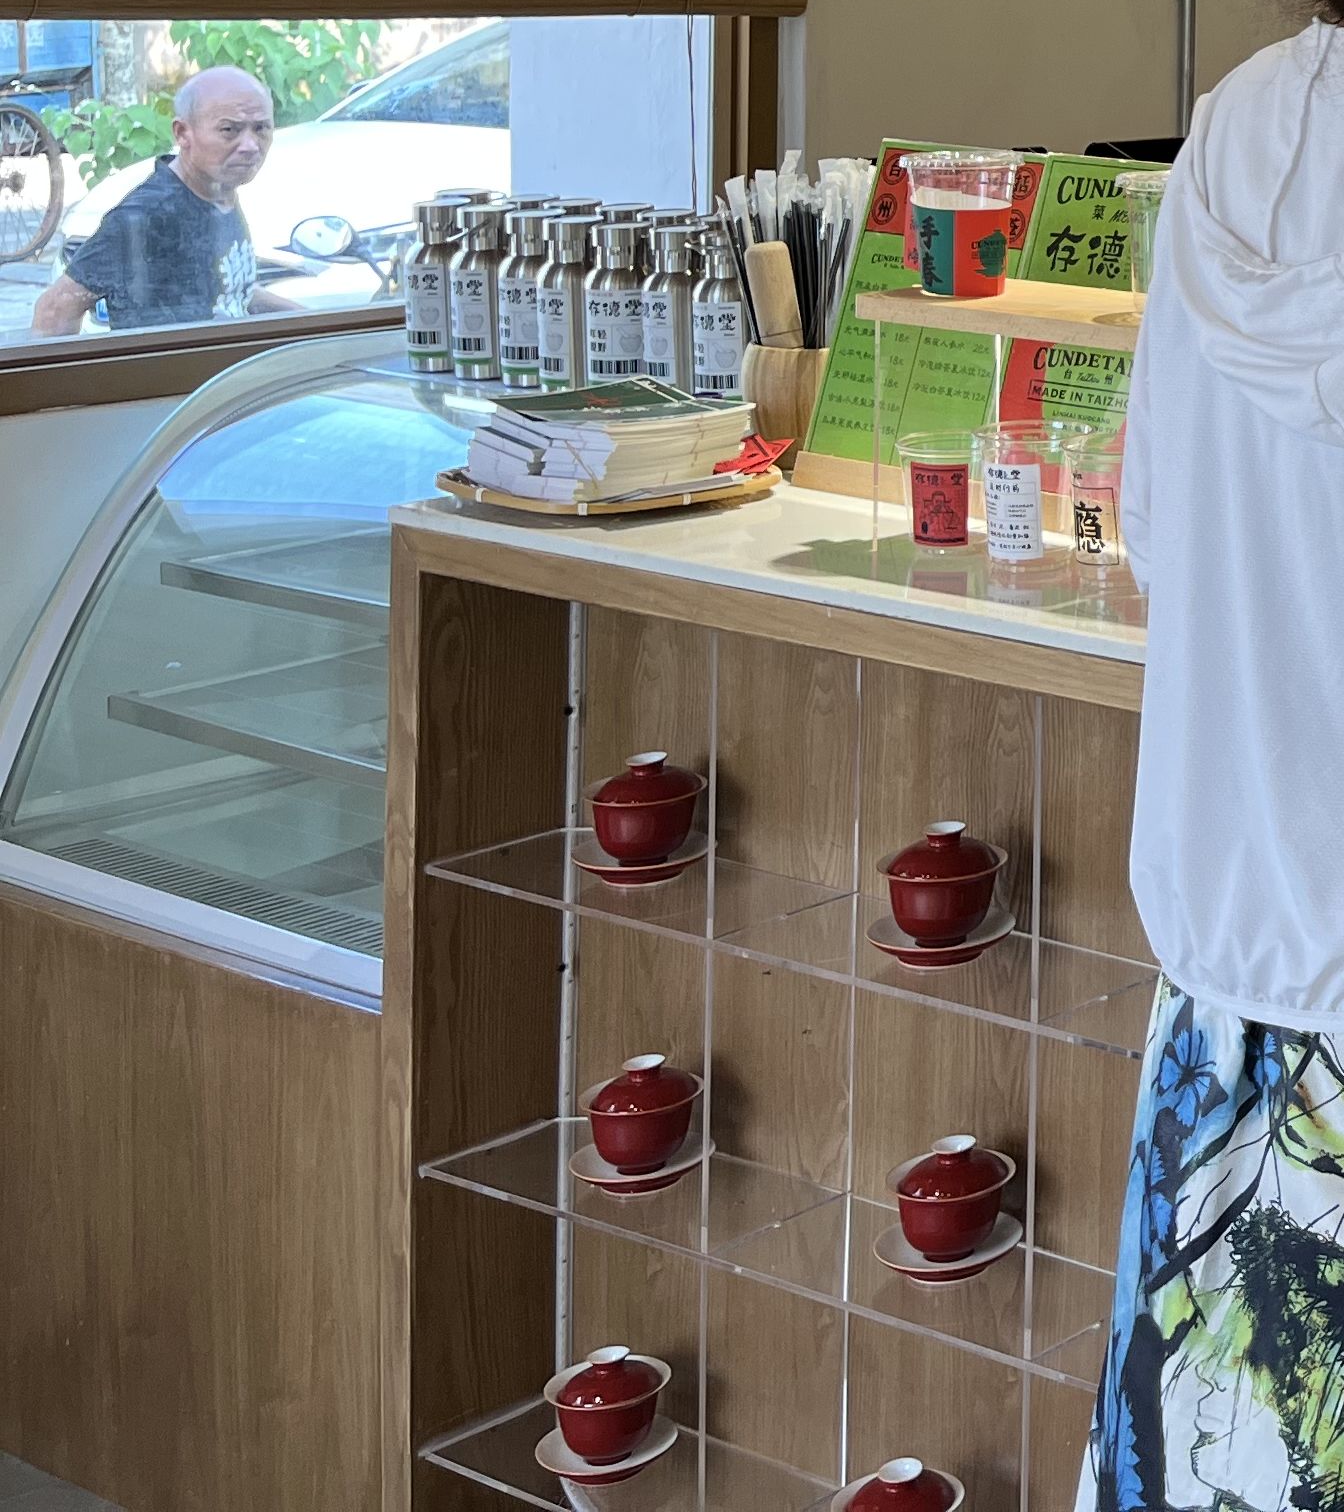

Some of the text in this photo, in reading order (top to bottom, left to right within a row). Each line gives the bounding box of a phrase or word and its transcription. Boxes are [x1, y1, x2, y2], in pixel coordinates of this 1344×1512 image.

[878, 200, 892, 218] 州
[1032, 385, 1067, 400] MADE
[1069, 391, 1084, 402] IN
